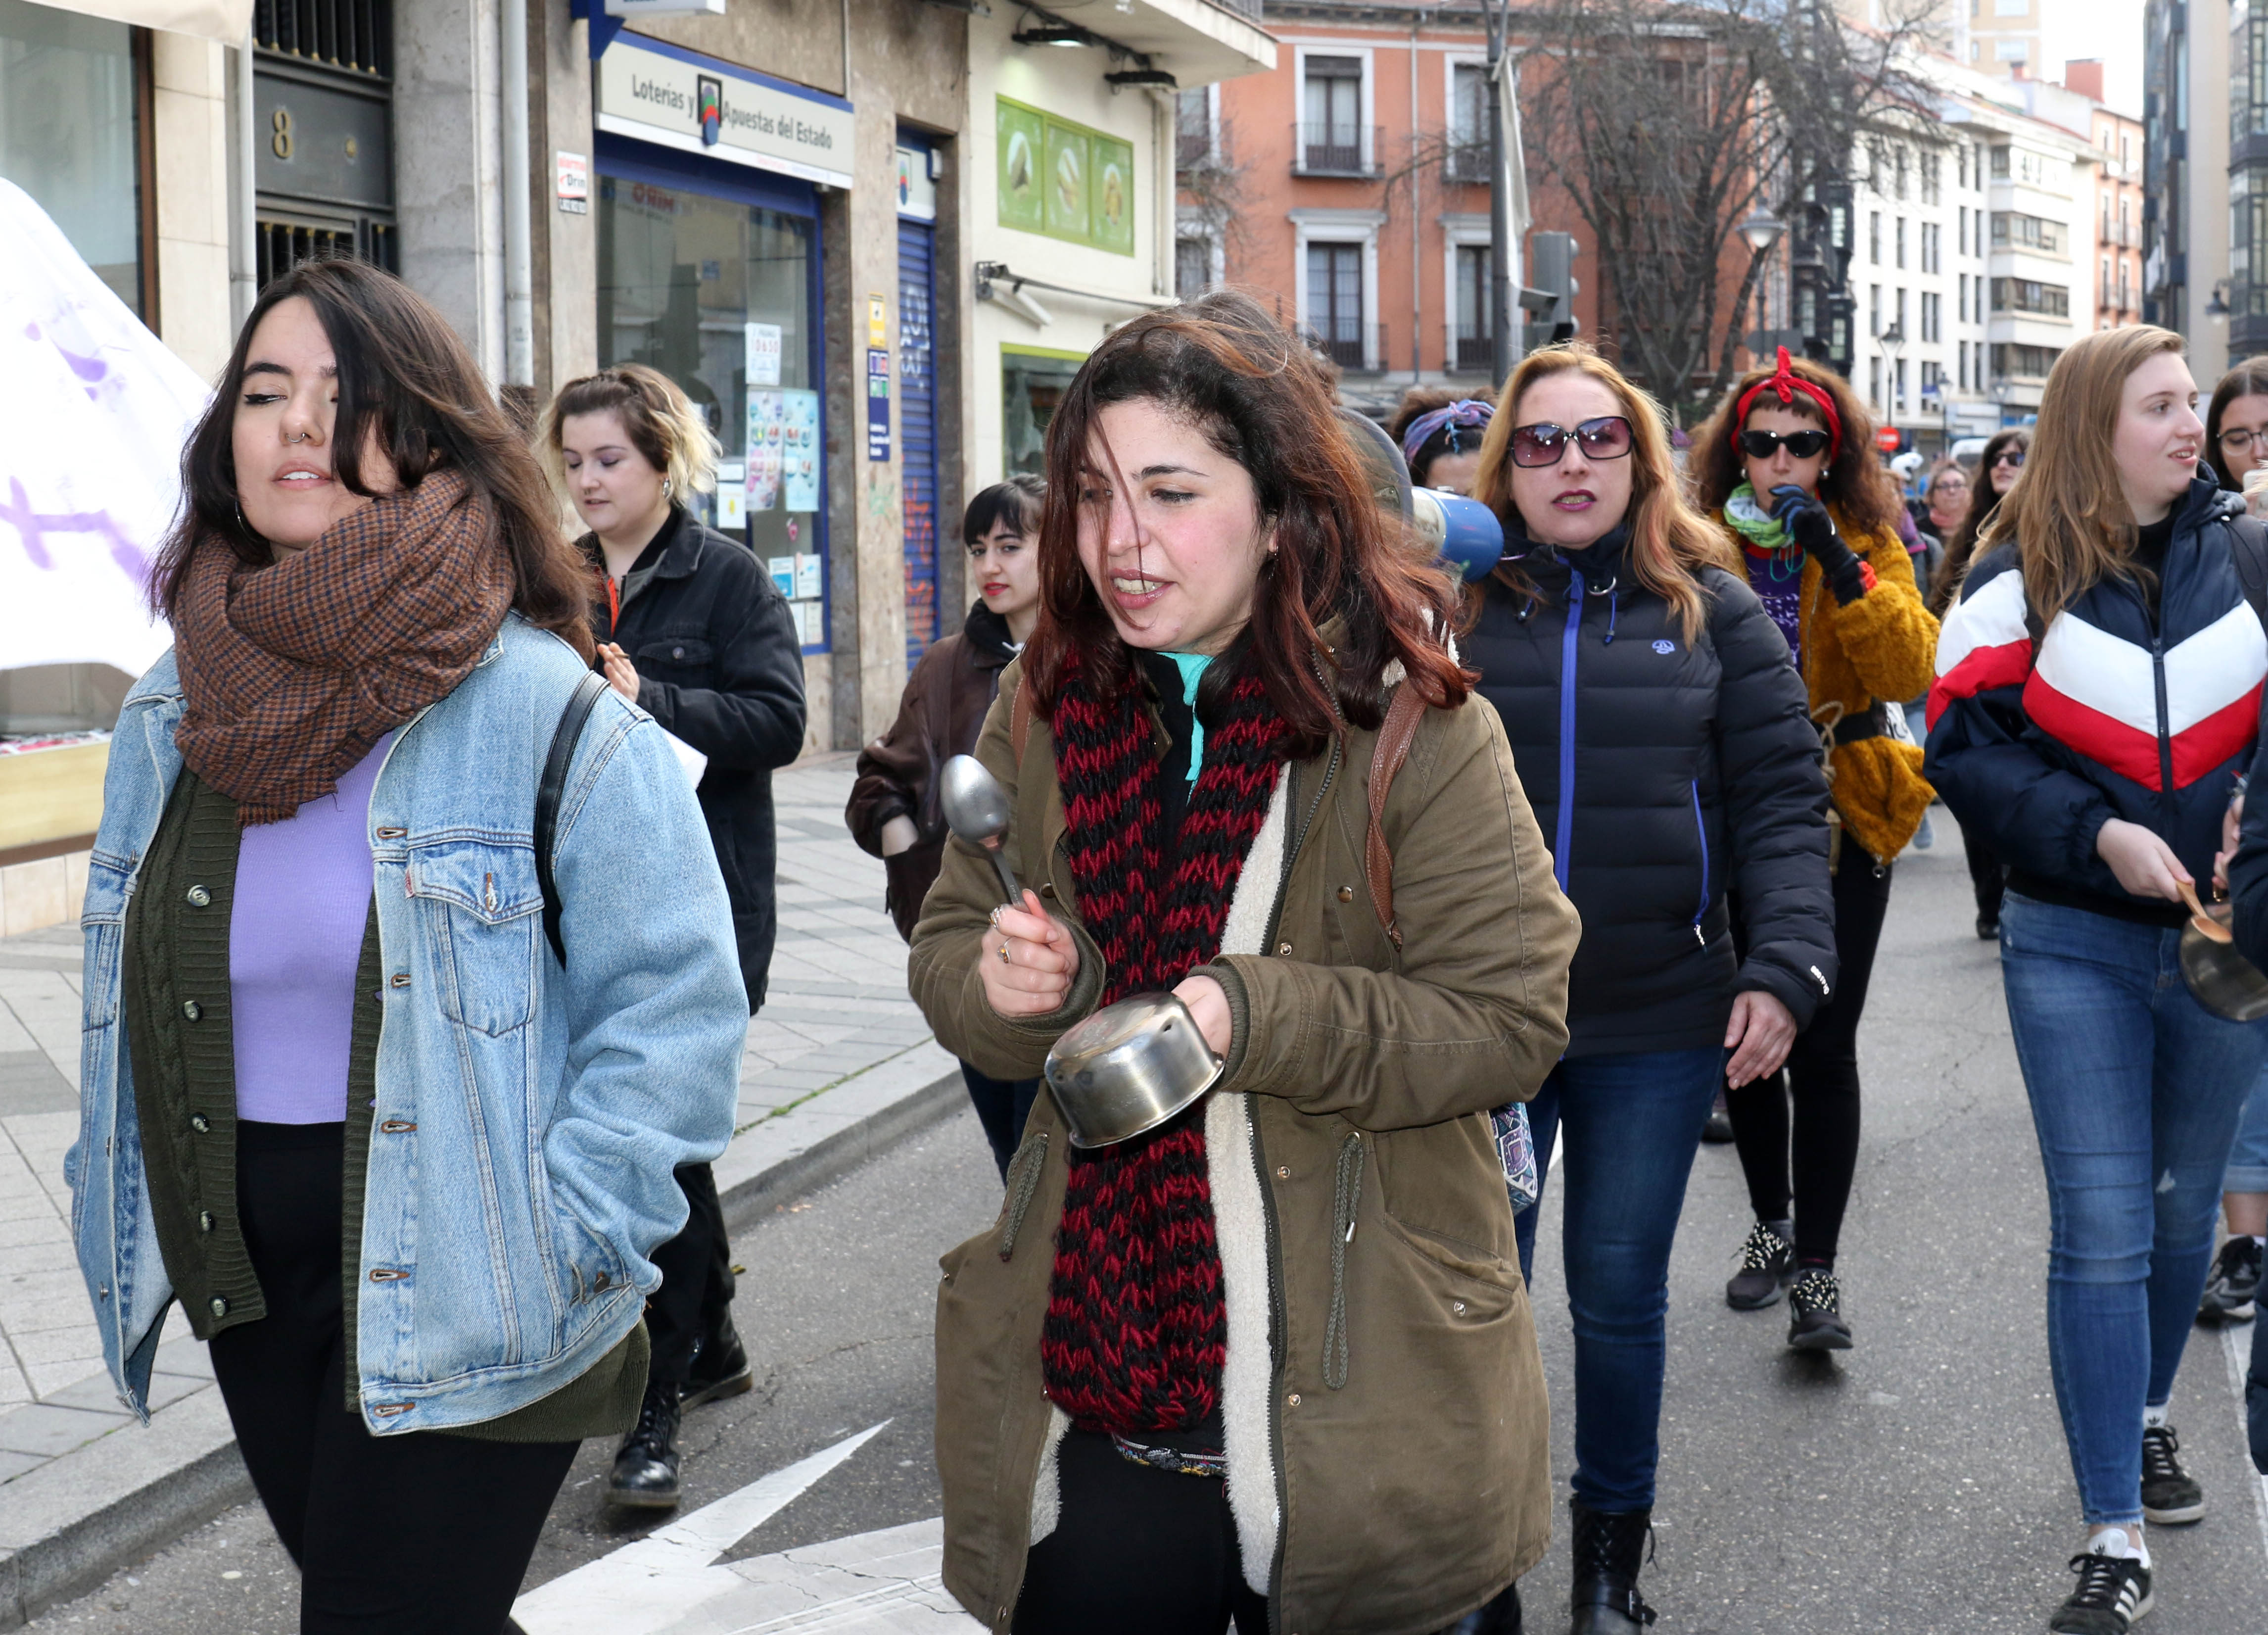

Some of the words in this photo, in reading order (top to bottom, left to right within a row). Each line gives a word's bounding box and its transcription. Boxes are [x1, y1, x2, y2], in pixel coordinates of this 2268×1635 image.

[273, 110, 293, 159] 8
[632, 74, 684, 109] Loterías
[688, 95, 695, 118] y
[723, 100, 774, 134] Apuestas
[778, 114, 793, 140] del
[797, 121, 832, 149] Estado
